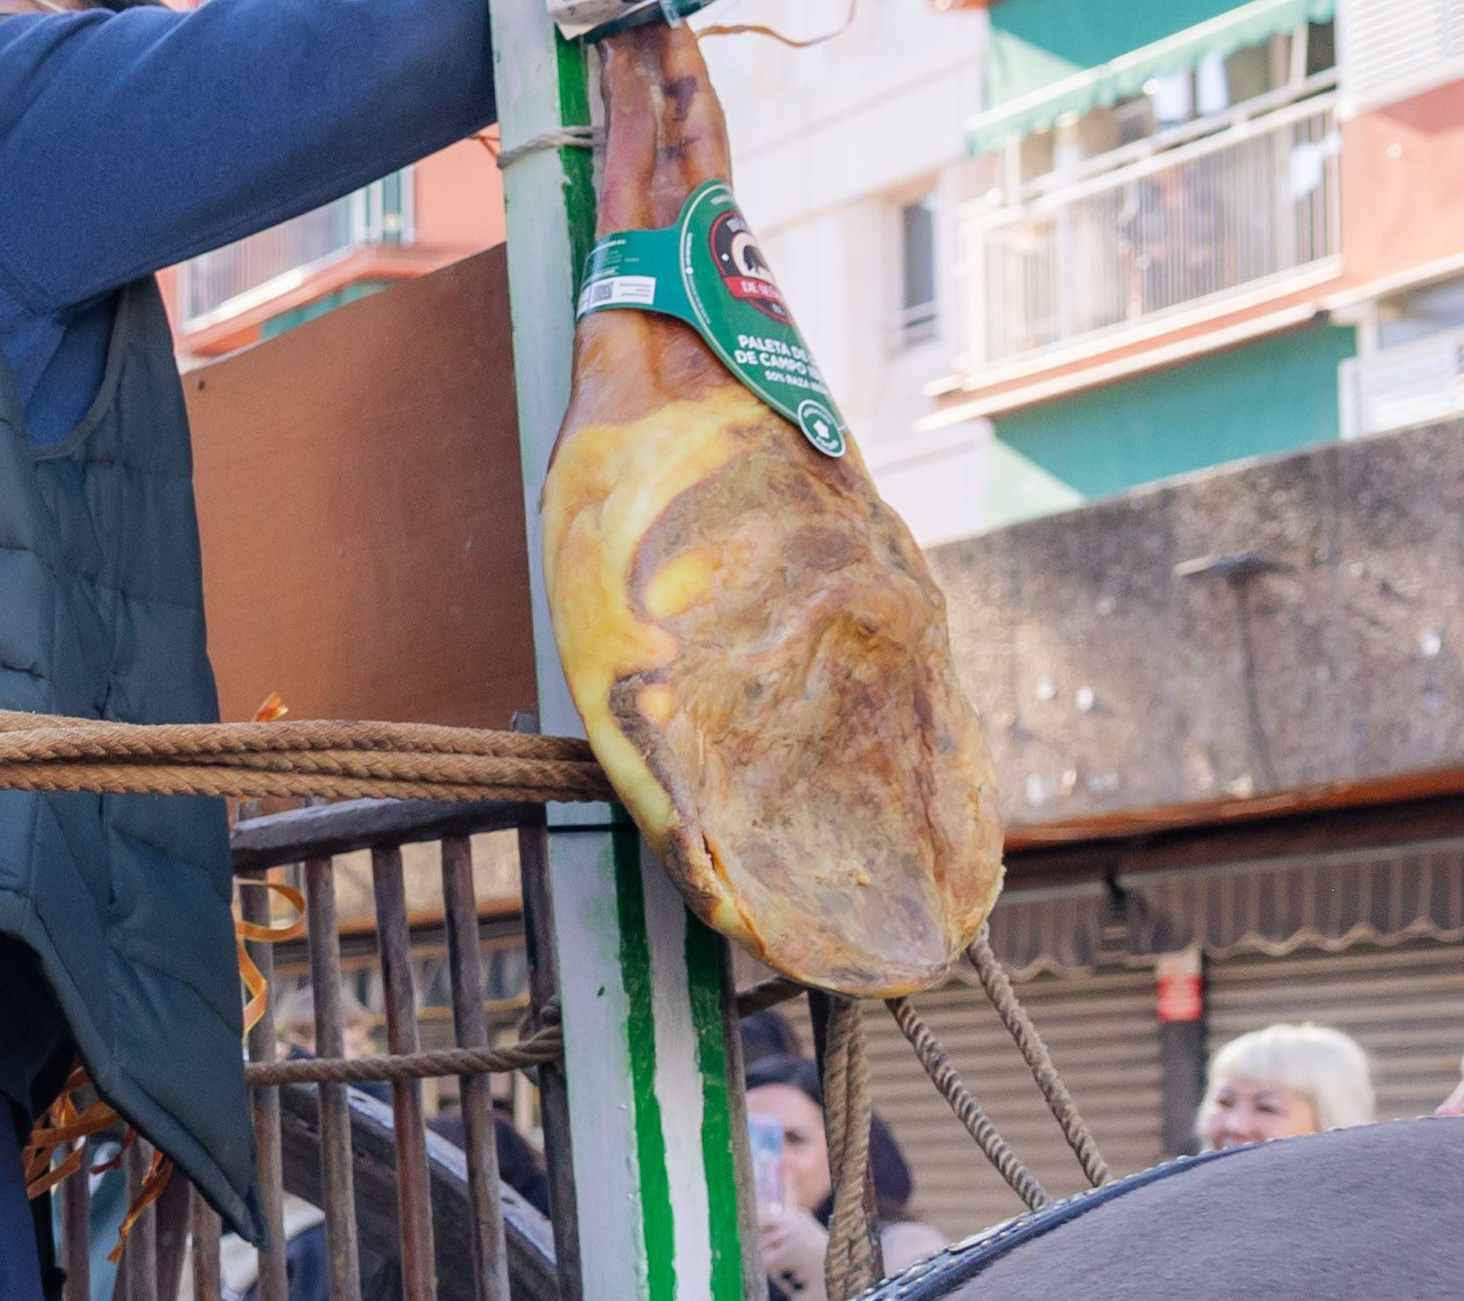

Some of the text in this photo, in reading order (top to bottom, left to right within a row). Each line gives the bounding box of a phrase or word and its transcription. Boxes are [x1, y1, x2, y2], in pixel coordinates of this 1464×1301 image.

[737, 334, 791, 356] PALETA
[734, 349, 759, 365] DE
[759, 352, 807, 375] CAMPO
